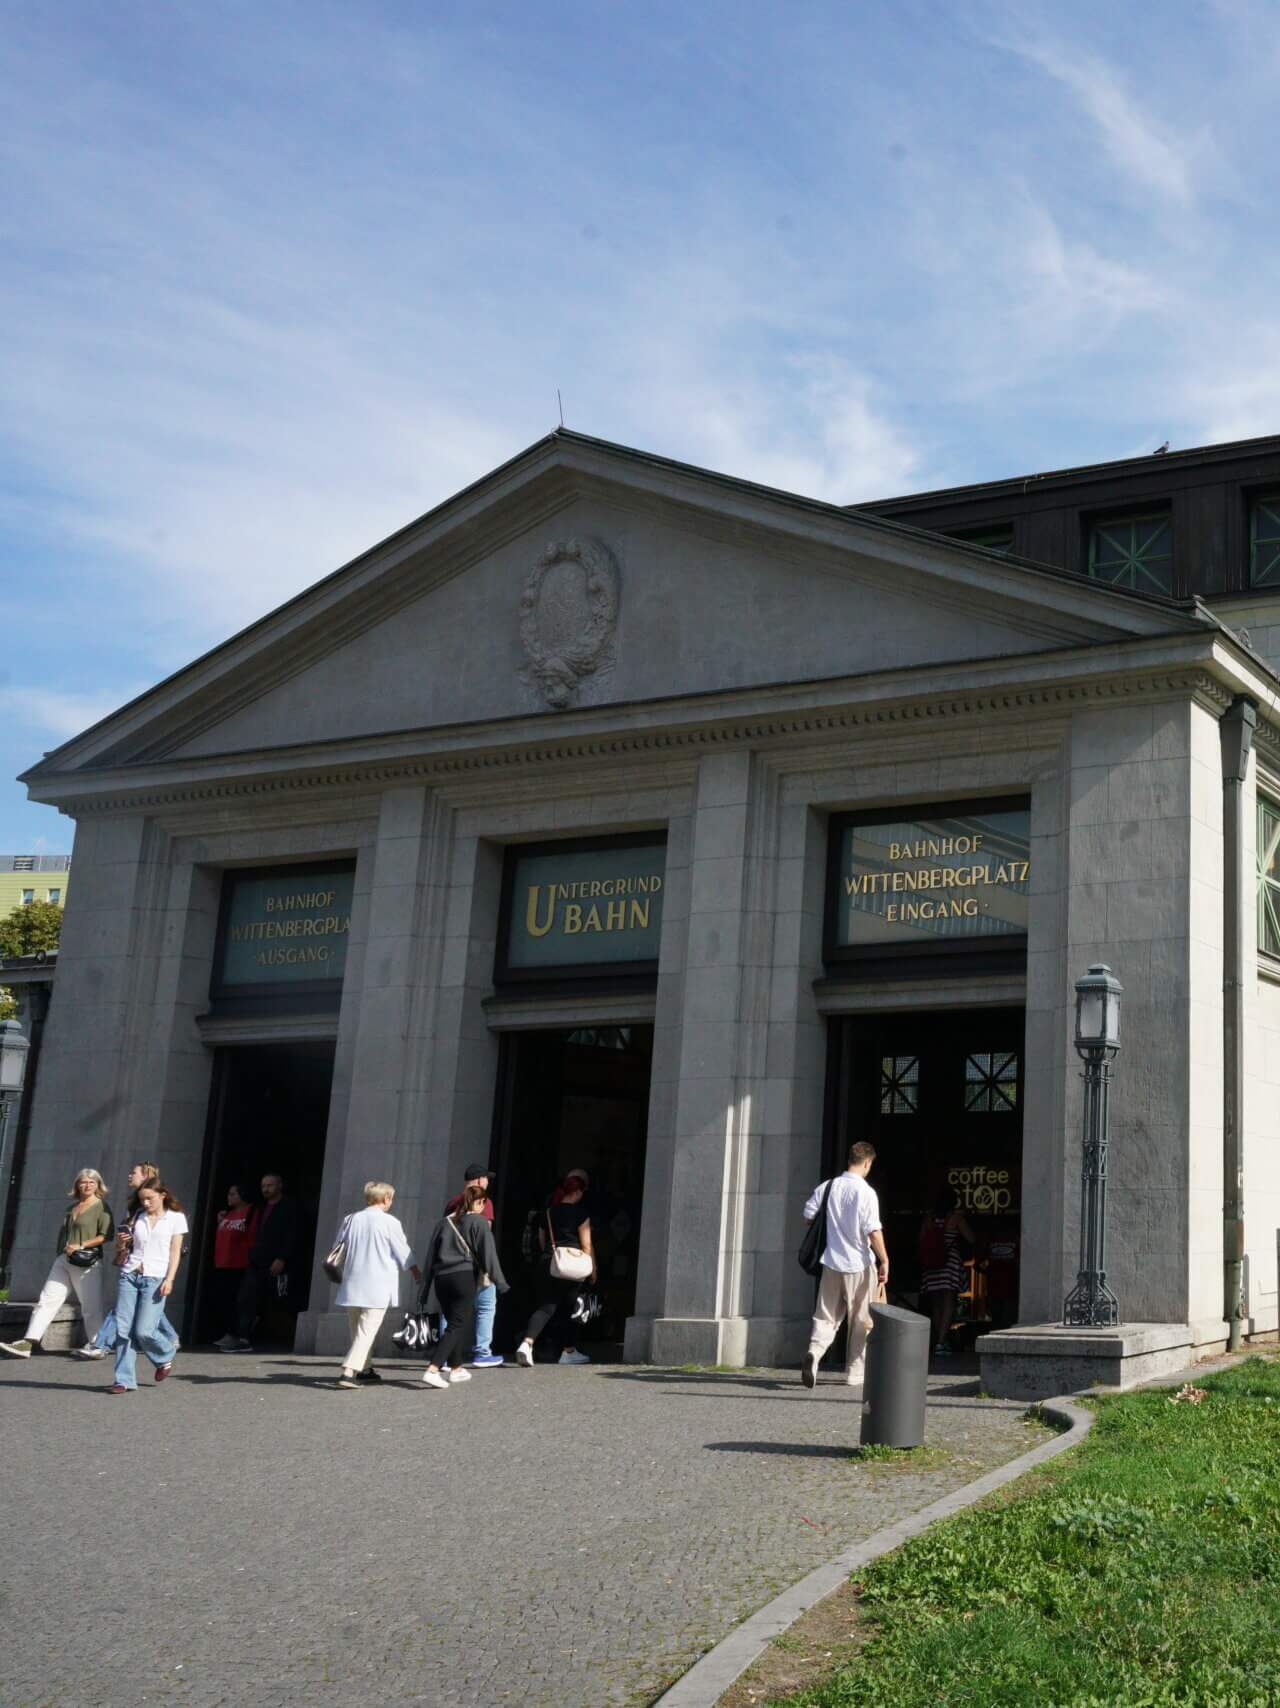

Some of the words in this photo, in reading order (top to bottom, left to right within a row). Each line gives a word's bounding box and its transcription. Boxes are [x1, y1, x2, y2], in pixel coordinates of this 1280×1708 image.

[889, 835, 984, 860] BAHNHOF
[844, 862, 1030, 895] WITTENBERGPLATZ
[266, 891, 336, 912] BAHNHOF
[887, 899, 978, 921] EINGANG
[563, 899, 650, 934] BAHN
[257, 946, 329, 965] AUSGANG
[948, 1166, 1009, 1185] coffee
